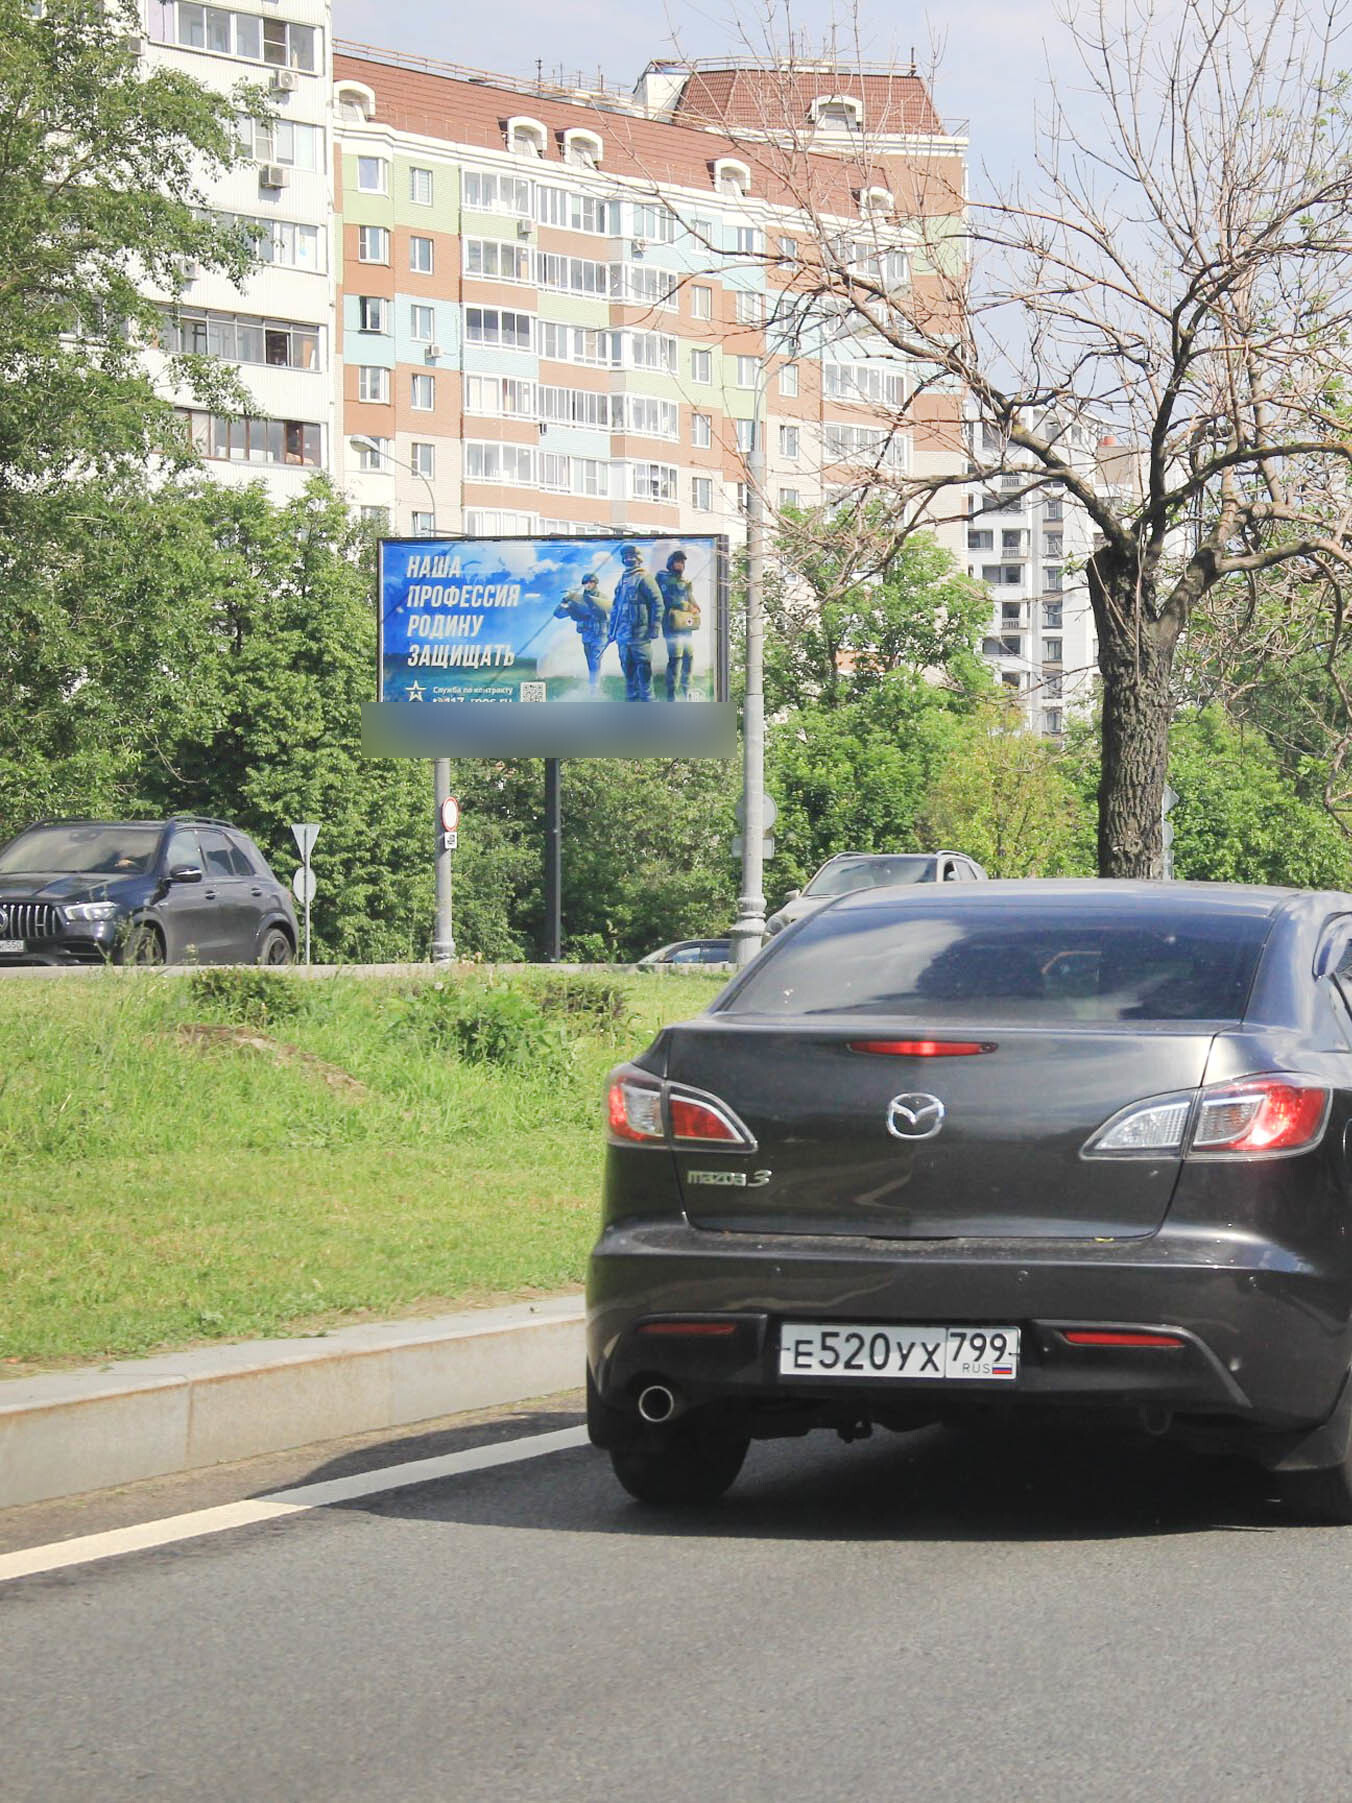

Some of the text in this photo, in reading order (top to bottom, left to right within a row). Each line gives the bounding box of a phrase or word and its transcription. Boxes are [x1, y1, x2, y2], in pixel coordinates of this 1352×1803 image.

[407, 556, 461, 578] НАША
[407, 584, 521, 607] ПРОФЕССИЯ
[407, 615, 484, 639] РОДИНУ
[407, 644, 515, 668] ЗАЩИЩАТЬ
[949, 1332, 1008, 1362] 799
[962, 1363, 991, 1374] RUS
